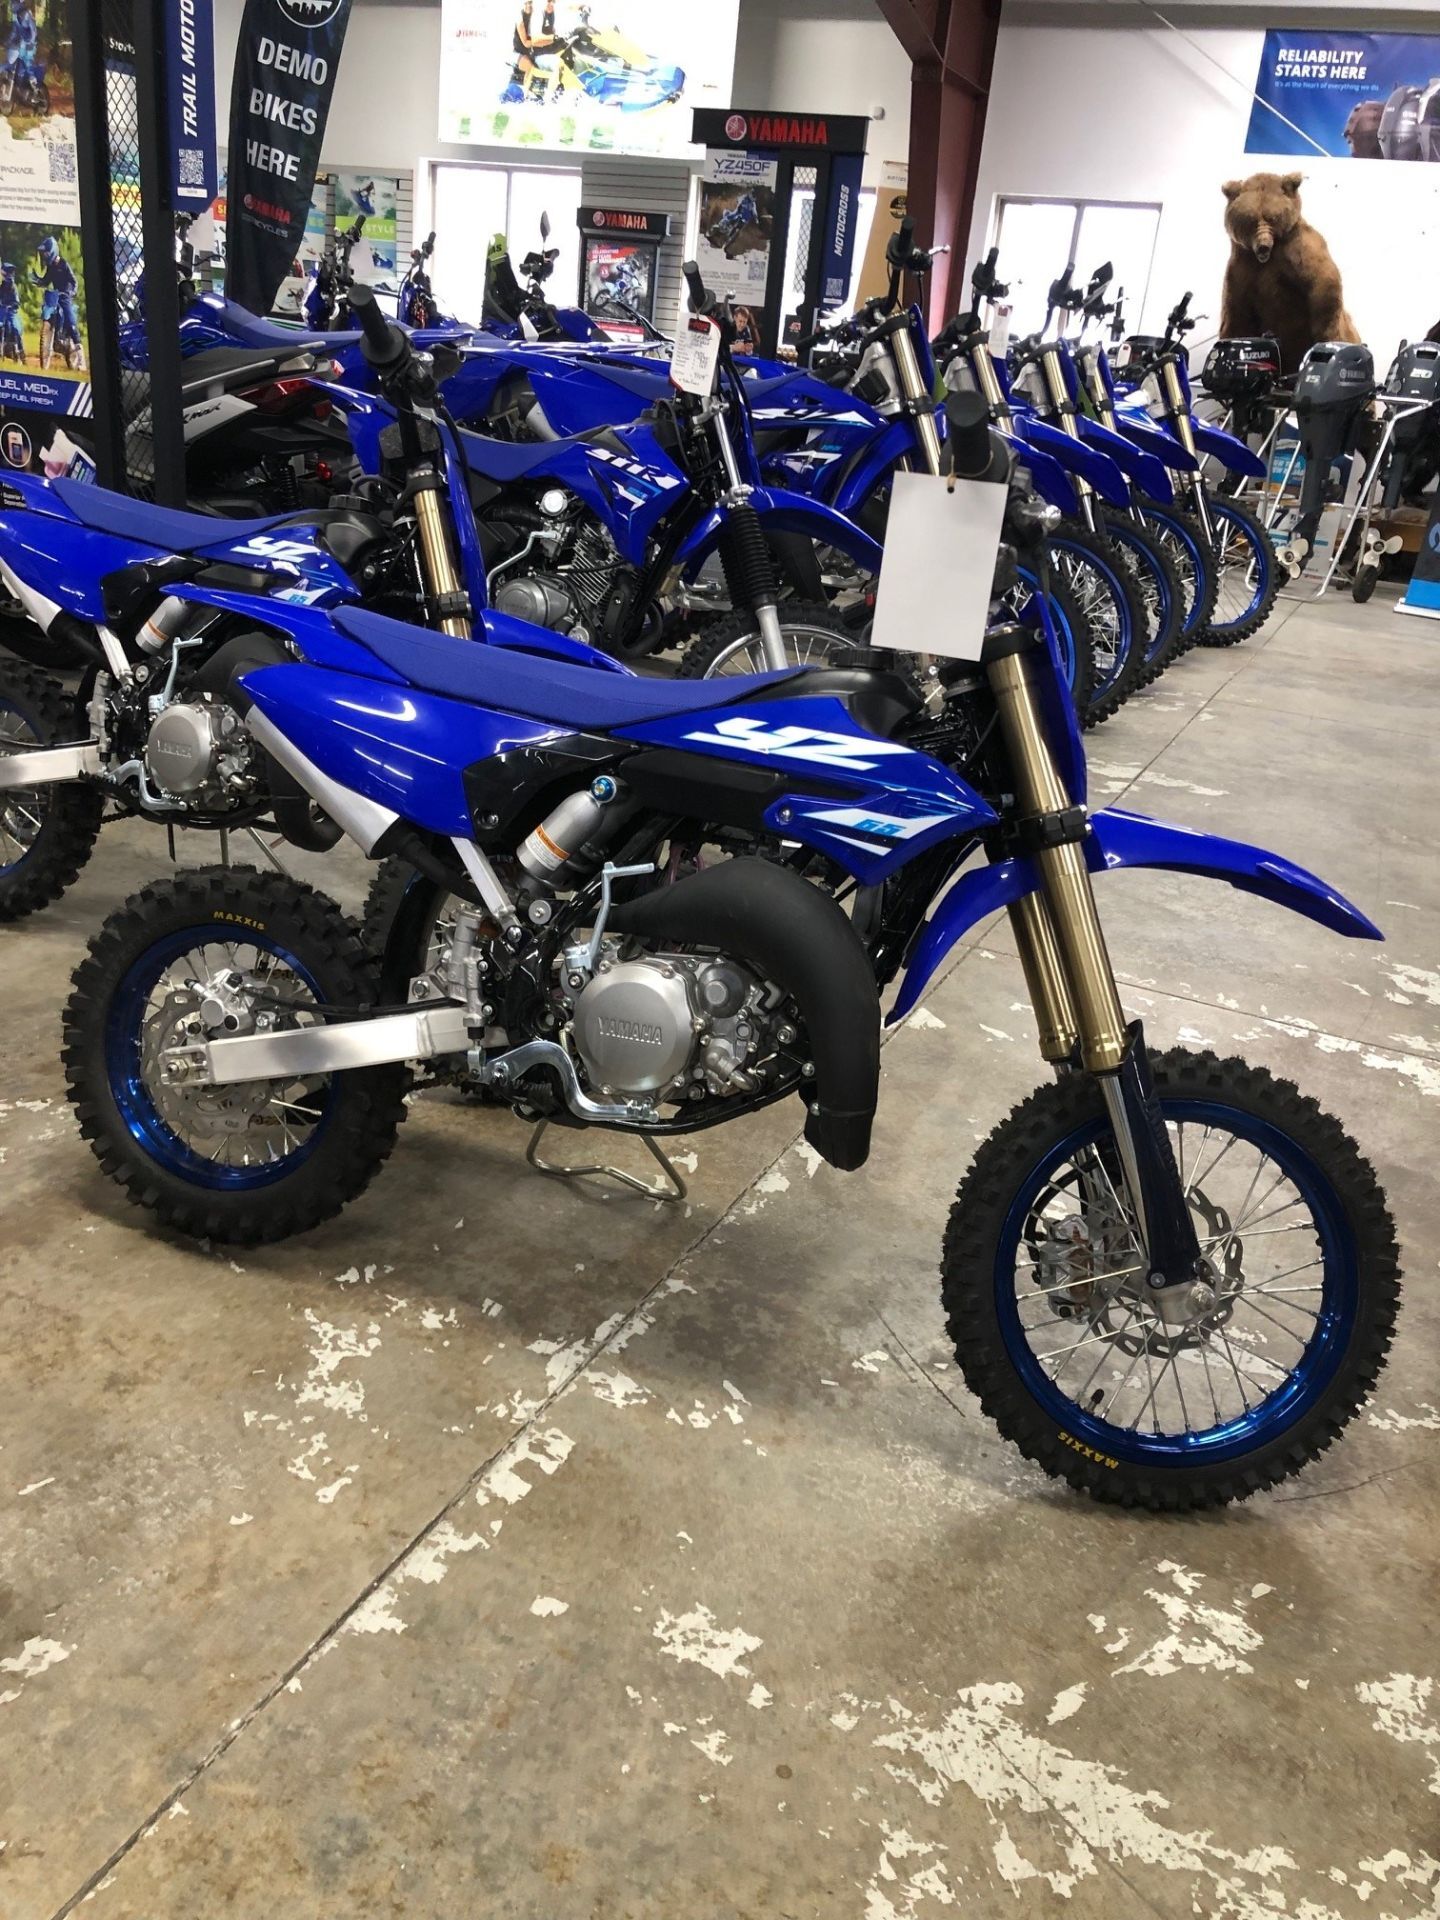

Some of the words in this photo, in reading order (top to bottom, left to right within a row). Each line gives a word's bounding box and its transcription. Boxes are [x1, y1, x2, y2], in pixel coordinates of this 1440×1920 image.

[257, 37, 328, 85] DEMO
[1278, 49, 1363, 64] RELIABILITY
[1275, 64, 1328, 78] STARTS
[1330, 66, 1367, 80] HERE
[1328, 82, 1360, 92] everything
[182, 73, 198, 137] TRAIL
[249, 88, 318, 136] BIKES
[749, 117, 827, 145] YAMAHA
[246, 138, 301, 182] HERE
[714, 158, 771, 172] YZ450F
[605, 212, 647, 230] YAMAHA
[834, 184, 850, 257] MOTOCROSS
[1305, 375, 1320, 383] 15
[1410, 367, 1433, 379] 20
[0, 379, 21, 391] UEL
[680, 717, 918, 771] YZ
[852, 818, 907, 837] 65
[213, 911, 265, 931] MAXXIS
[598, 1016, 662, 1046] YAMAHA
[1058, 1432, 1119, 1470] MAXXIS
